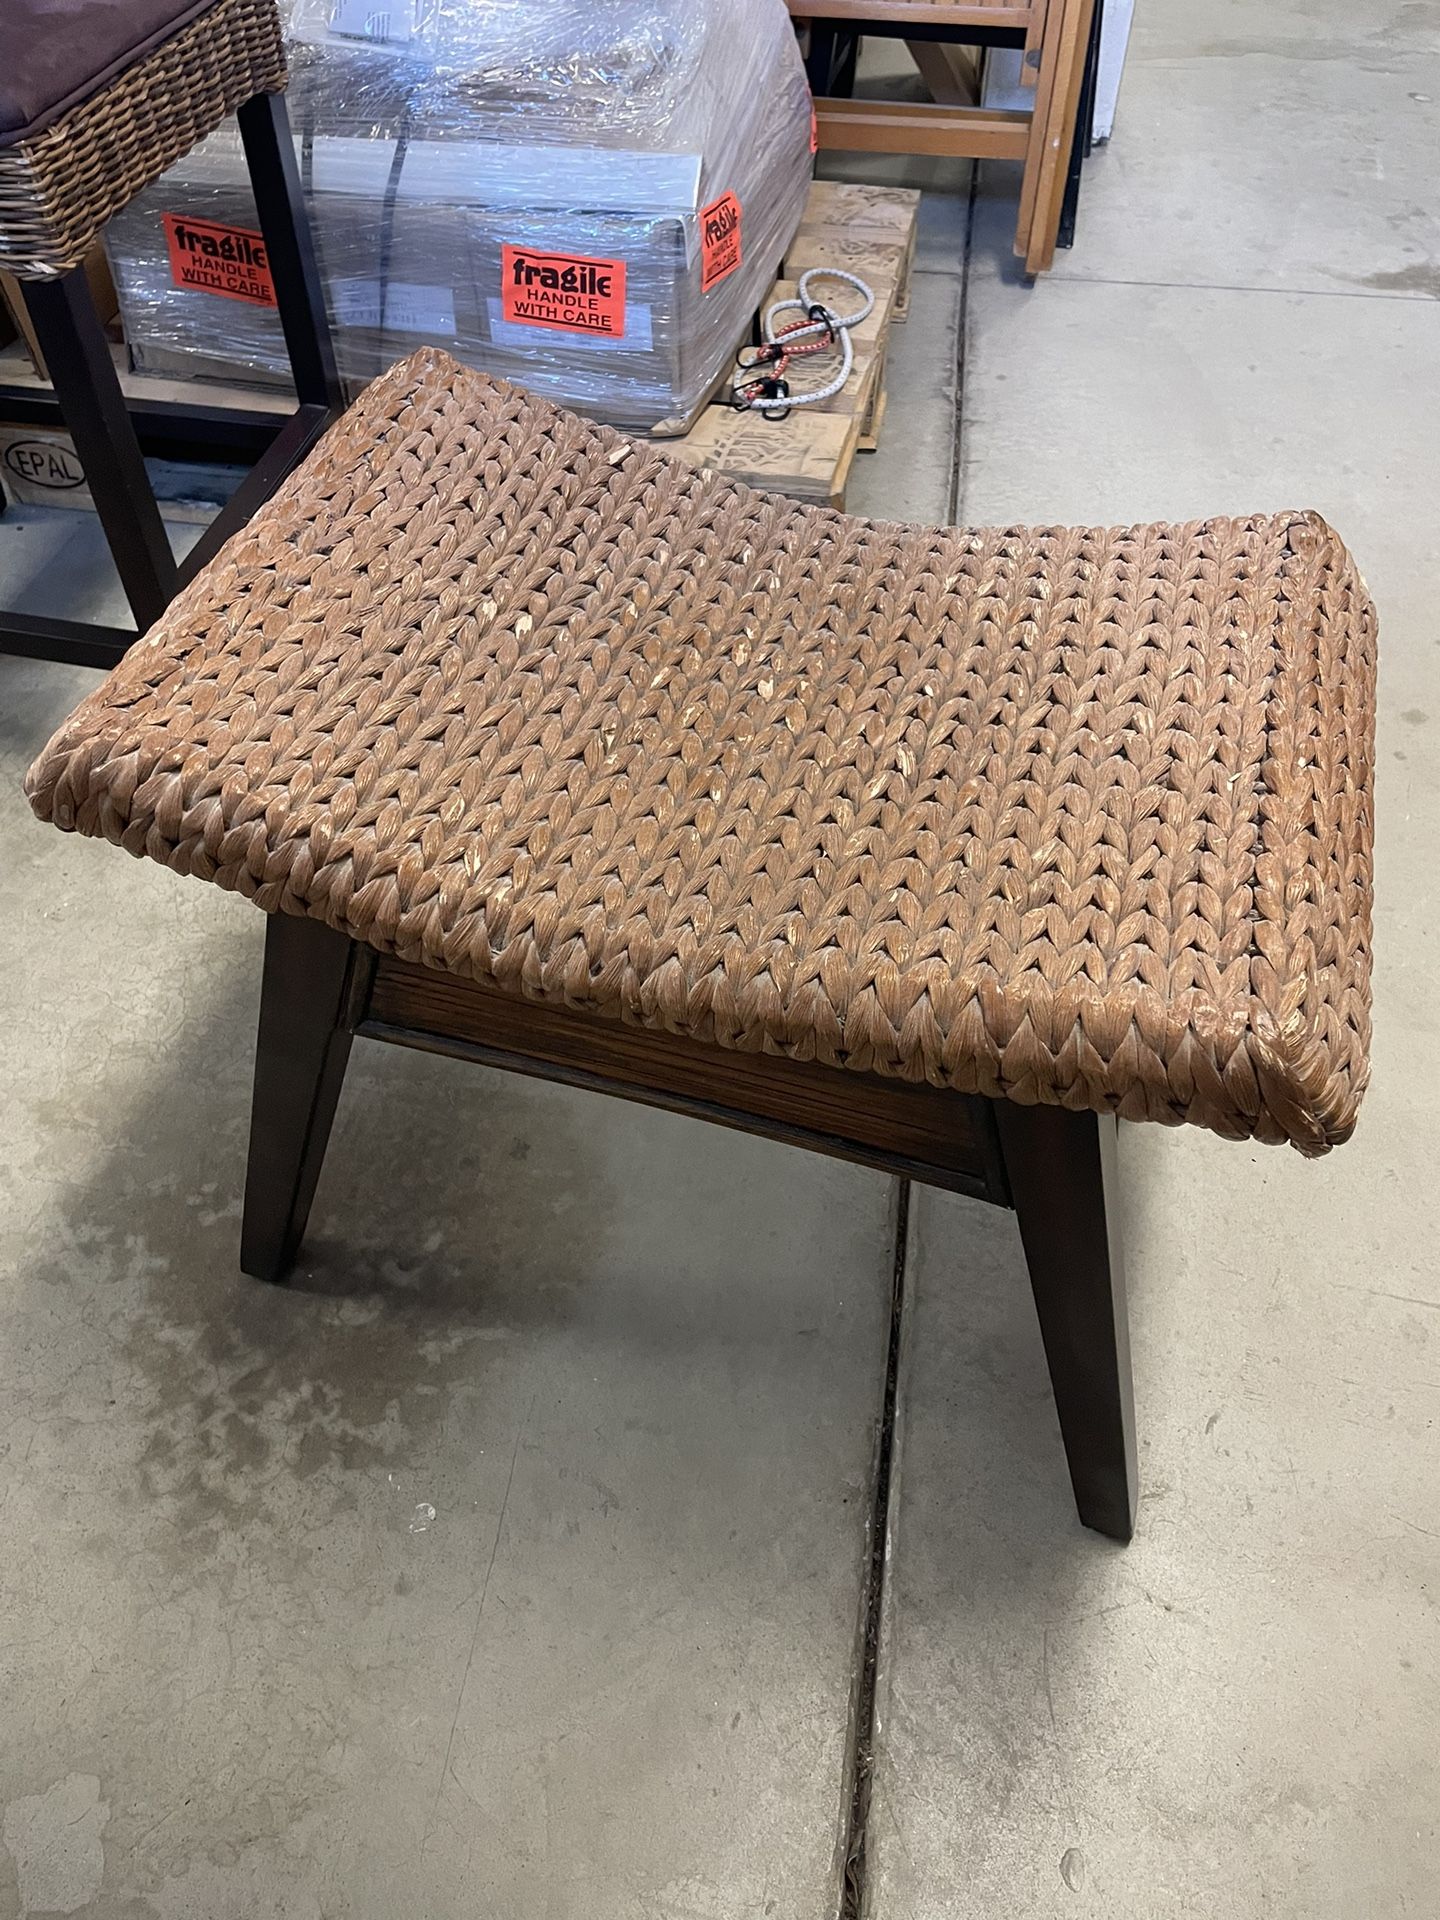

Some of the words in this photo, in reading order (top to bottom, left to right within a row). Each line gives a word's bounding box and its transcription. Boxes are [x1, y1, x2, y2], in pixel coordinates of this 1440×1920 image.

[174, 225, 267, 269] fragile
[181, 267, 222, 286] WITH
[227, 277, 271, 298] CARE
[191, 255, 258, 280] HANDLE
[513, 258, 612, 298] fragile
[514, 300, 557, 319] WITH
[563, 309, 612, 327] CARE
[527, 288, 599, 310] HANDLE
[15, 450, 80, 480] EPAL
